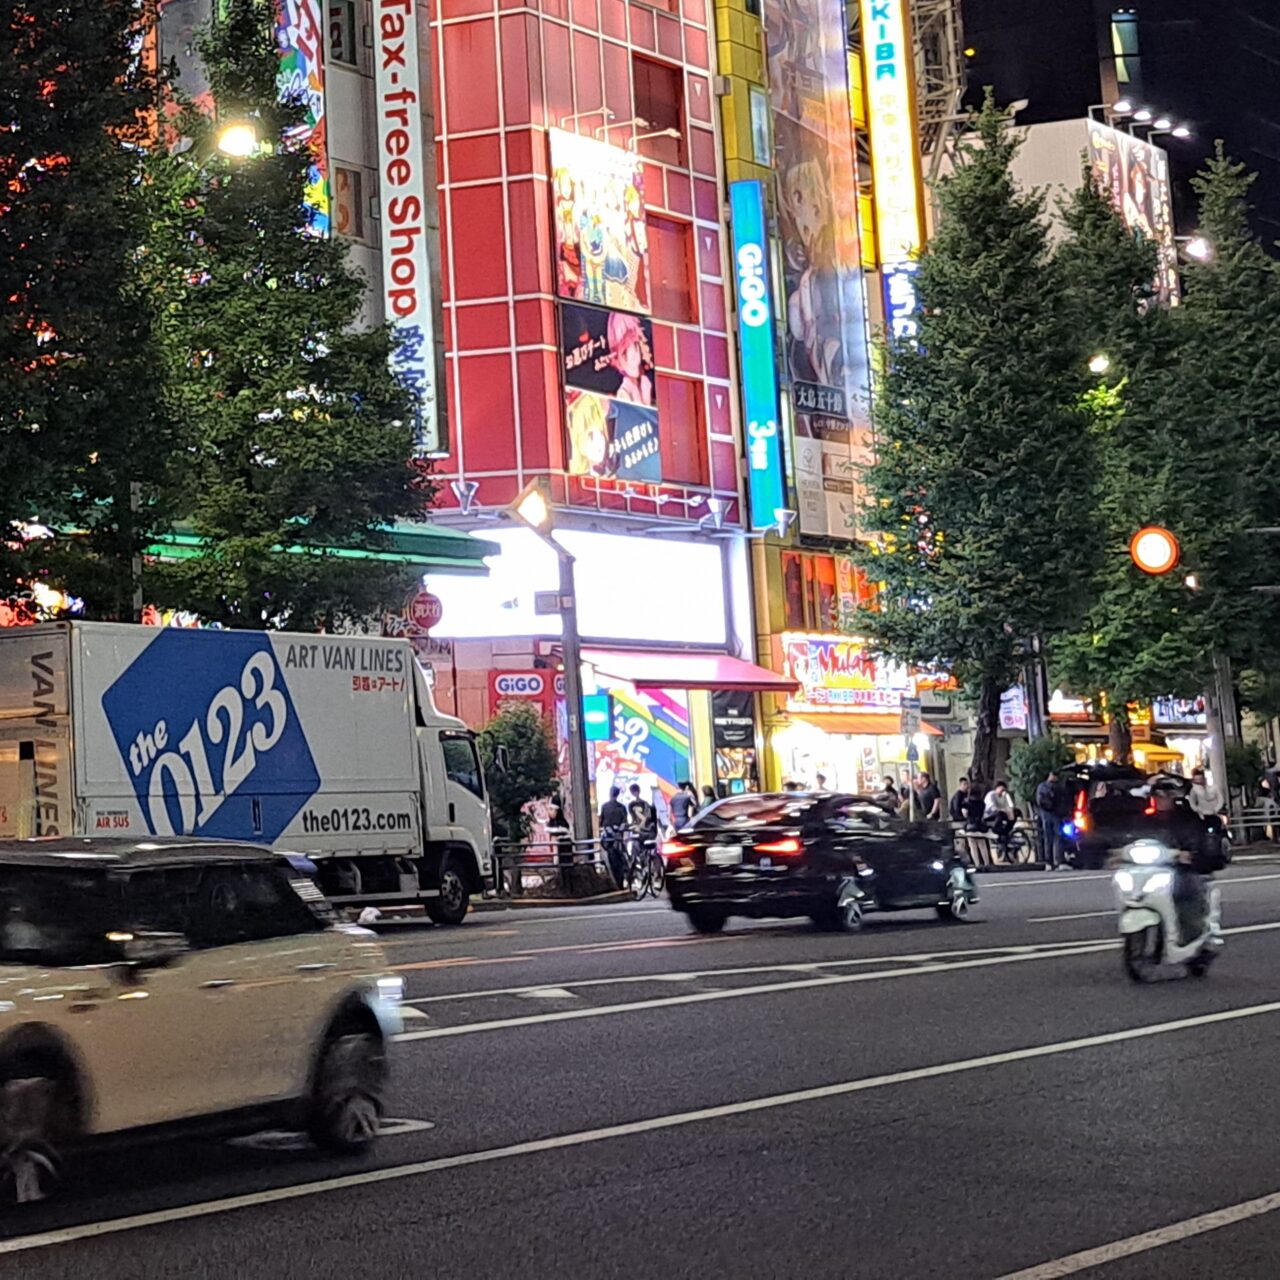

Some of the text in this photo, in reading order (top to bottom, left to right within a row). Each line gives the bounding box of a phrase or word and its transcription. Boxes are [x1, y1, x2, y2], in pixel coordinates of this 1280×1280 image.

[387, 195, 422, 317] Shop
[285, 644, 404, 672] ART VAN LINES
[498, 677, 541, 692] GiGO
[31, 651, 60, 837] VAN LINES
[129, 720, 168, 777] the
[148, 650, 287, 837] 0123
[95, 815, 131, 828] AIR SUS
[303, 808, 412, 833] the0123.com
